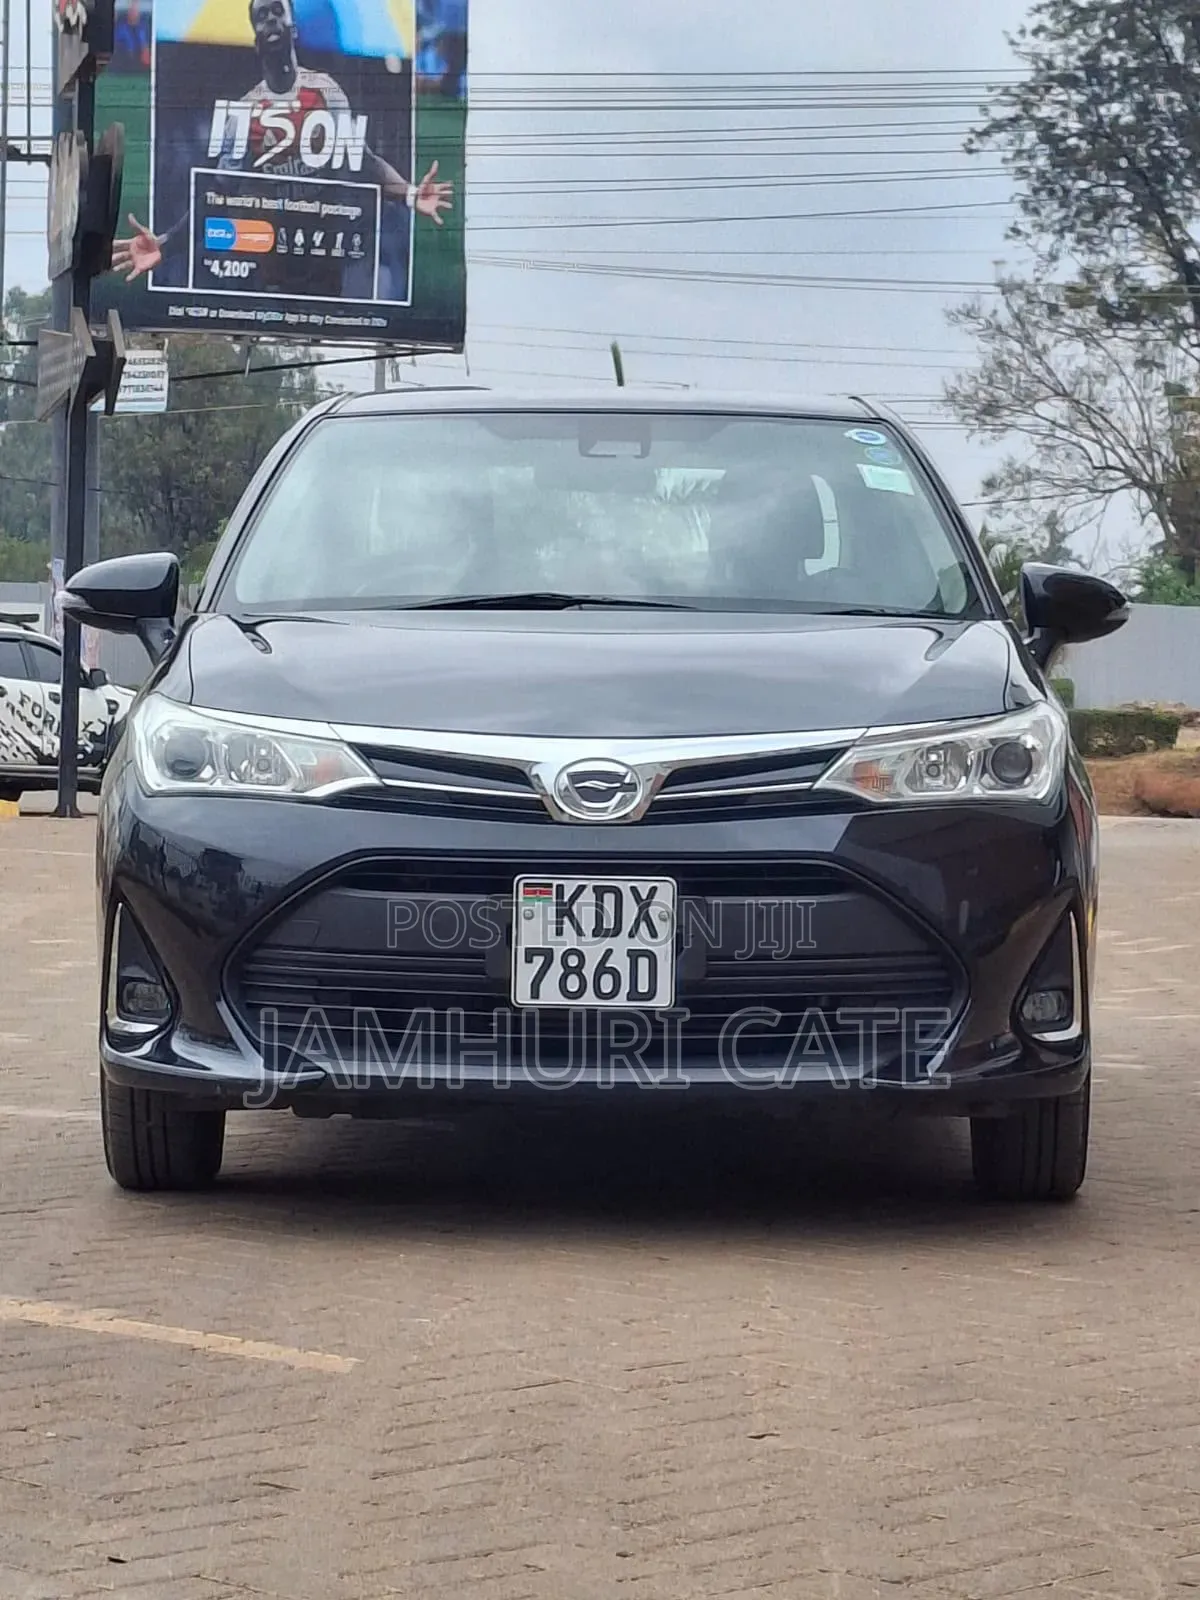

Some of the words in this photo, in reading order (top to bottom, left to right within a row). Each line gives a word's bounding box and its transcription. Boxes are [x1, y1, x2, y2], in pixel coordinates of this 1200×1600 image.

[300, 109, 368, 172] ON
[554, 883, 659, 939] KDX
[524, 947, 658, 1001] 786D
